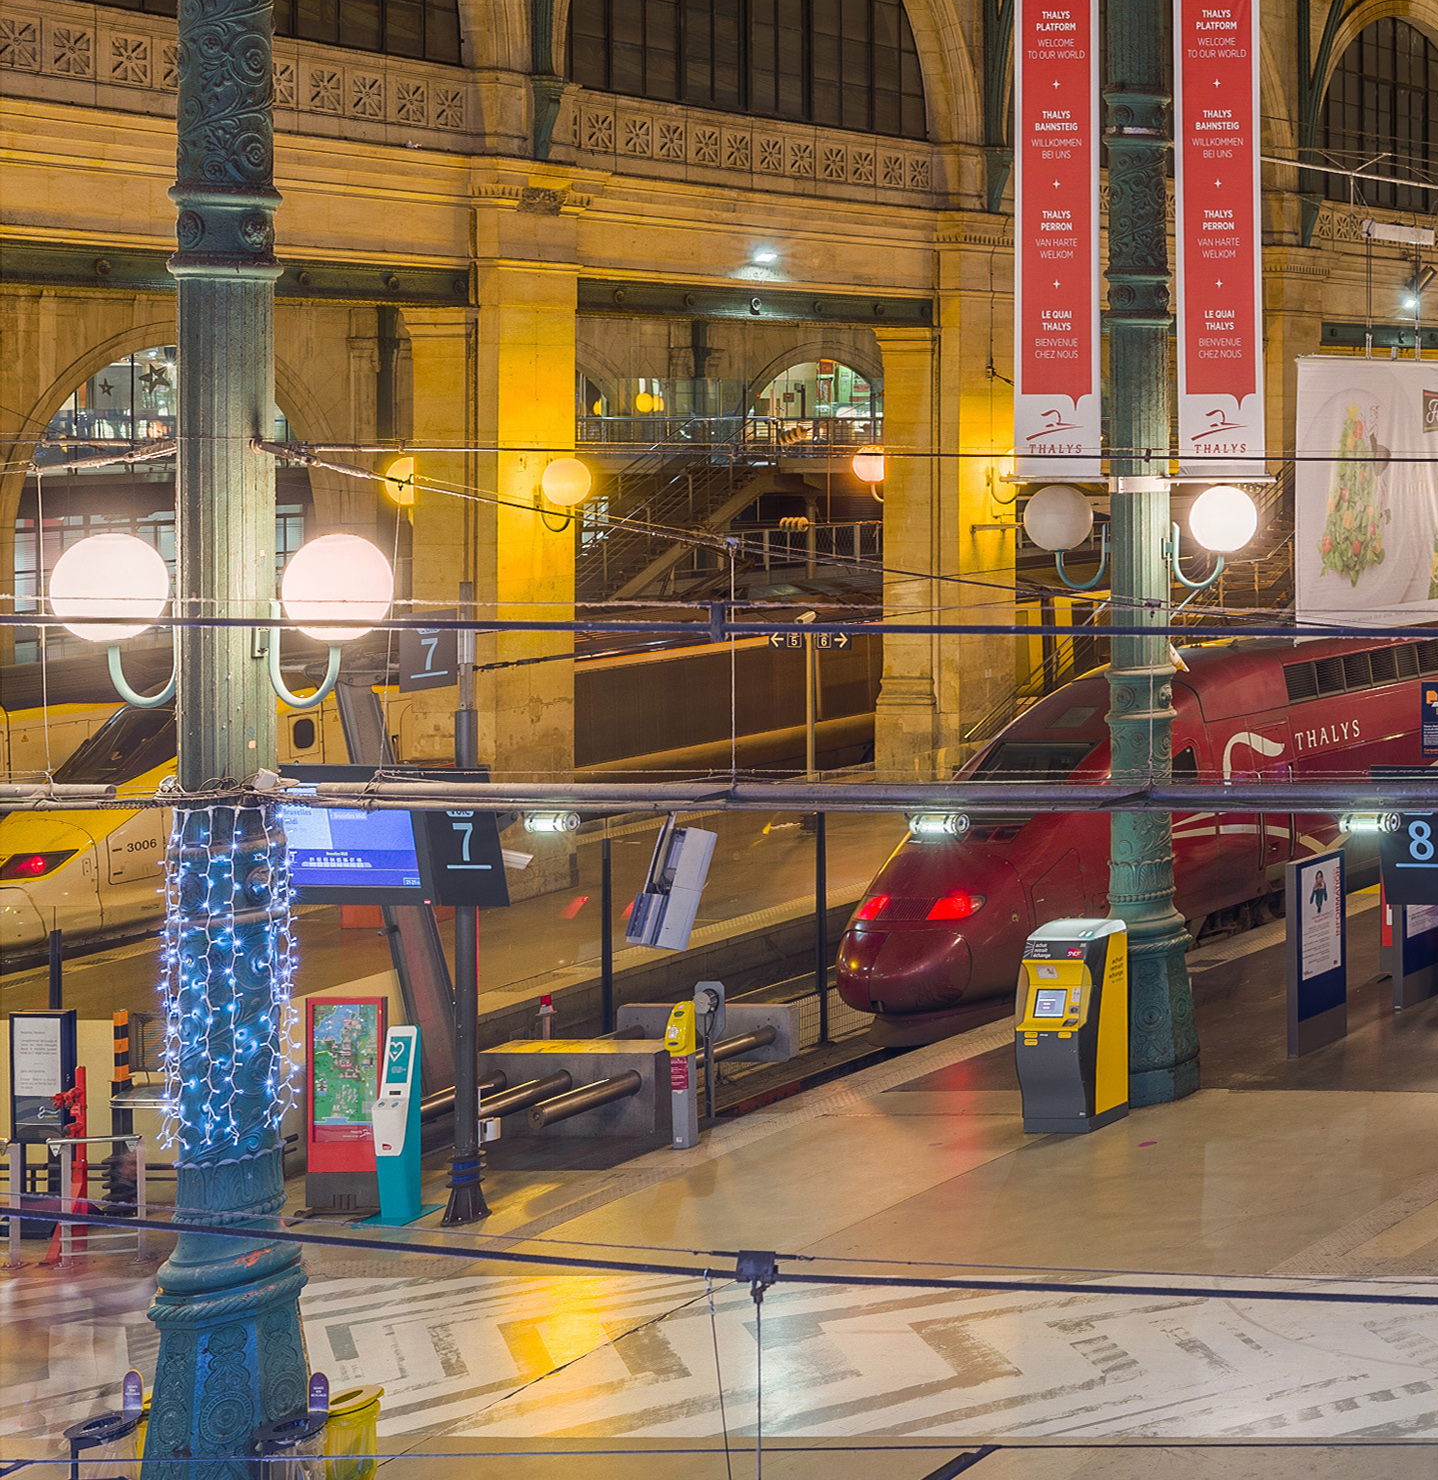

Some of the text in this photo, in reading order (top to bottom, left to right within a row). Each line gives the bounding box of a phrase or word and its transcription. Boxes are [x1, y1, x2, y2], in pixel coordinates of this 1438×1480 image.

[1042, 11, 1070, 19] THALYS
[1202, 10, 1231, 18] THALYS
[1036, 22, 1076, 31] PLATFORM
[1196, 22, 1237, 30] PLATFORM
[1038, 38, 1074, 47] WELCOME
[1198, 38, 1235, 46] WELCOME
[1028, 50, 1085, 59] TO OUR WORLD
[1188, 49, 1246, 58] TO OUR WORLD
[1042, 111, 1070, 119] THALYS
[1203, 110, 1232, 118] THALYS
[1035, 122, 1078, 131] BAHNSTEIG
[1196, 122, 1240, 130] BAHNSTEIG
[1031, 139, 1082, 147] WILLKOMMEN
[1192, 138, 1243, 146] WILLKOMMEN
[1042, 151, 1071, 159] BEI UNS
[1203, 150, 1233, 158] BEI UNS
[1042, 211, 1071, 219] THALYS
[1204, 210, 1233, 218] THALYS
[1041, 222, 1072, 231] PERRON
[1202, 222, 1235, 230] PERRON
[1035, 238, 1077, 246] VAN HARTE
[1198, 238, 1240, 246] VAN HARTE
[1040, 250, 1073, 259] WELKOM
[1202, 250, 1236, 258] WELKOM
[1042, 310, 1072, 319] LE QUAI
[1204, 310, 1235, 318] LE QUAI
[1042, 322, 1071, 331] THALYS
[1206, 322, 1235, 330] THALYS
[1035, 339, 1078, 347] BIENVENUE
[1199, 338, 1241, 346] BIENVENUE
[1035, 350, 1078, 359] CHEZ NOUS
[1198, 350, 1242, 358] CHEZ NOUS
[1029, 444, 1082, 454] THALYS
[1195, 444, 1246, 454] THALYS
[791, 637, 798, 646] 5
[821, 637, 827, 646] 6
[421, 638, 438, 671] 7
[1295, 719, 1361, 751] THALYS
[452, 823, 473, 862] 7
[1408, 820, 1434, 861] 8
[127, 839, 157, 852] 3006
